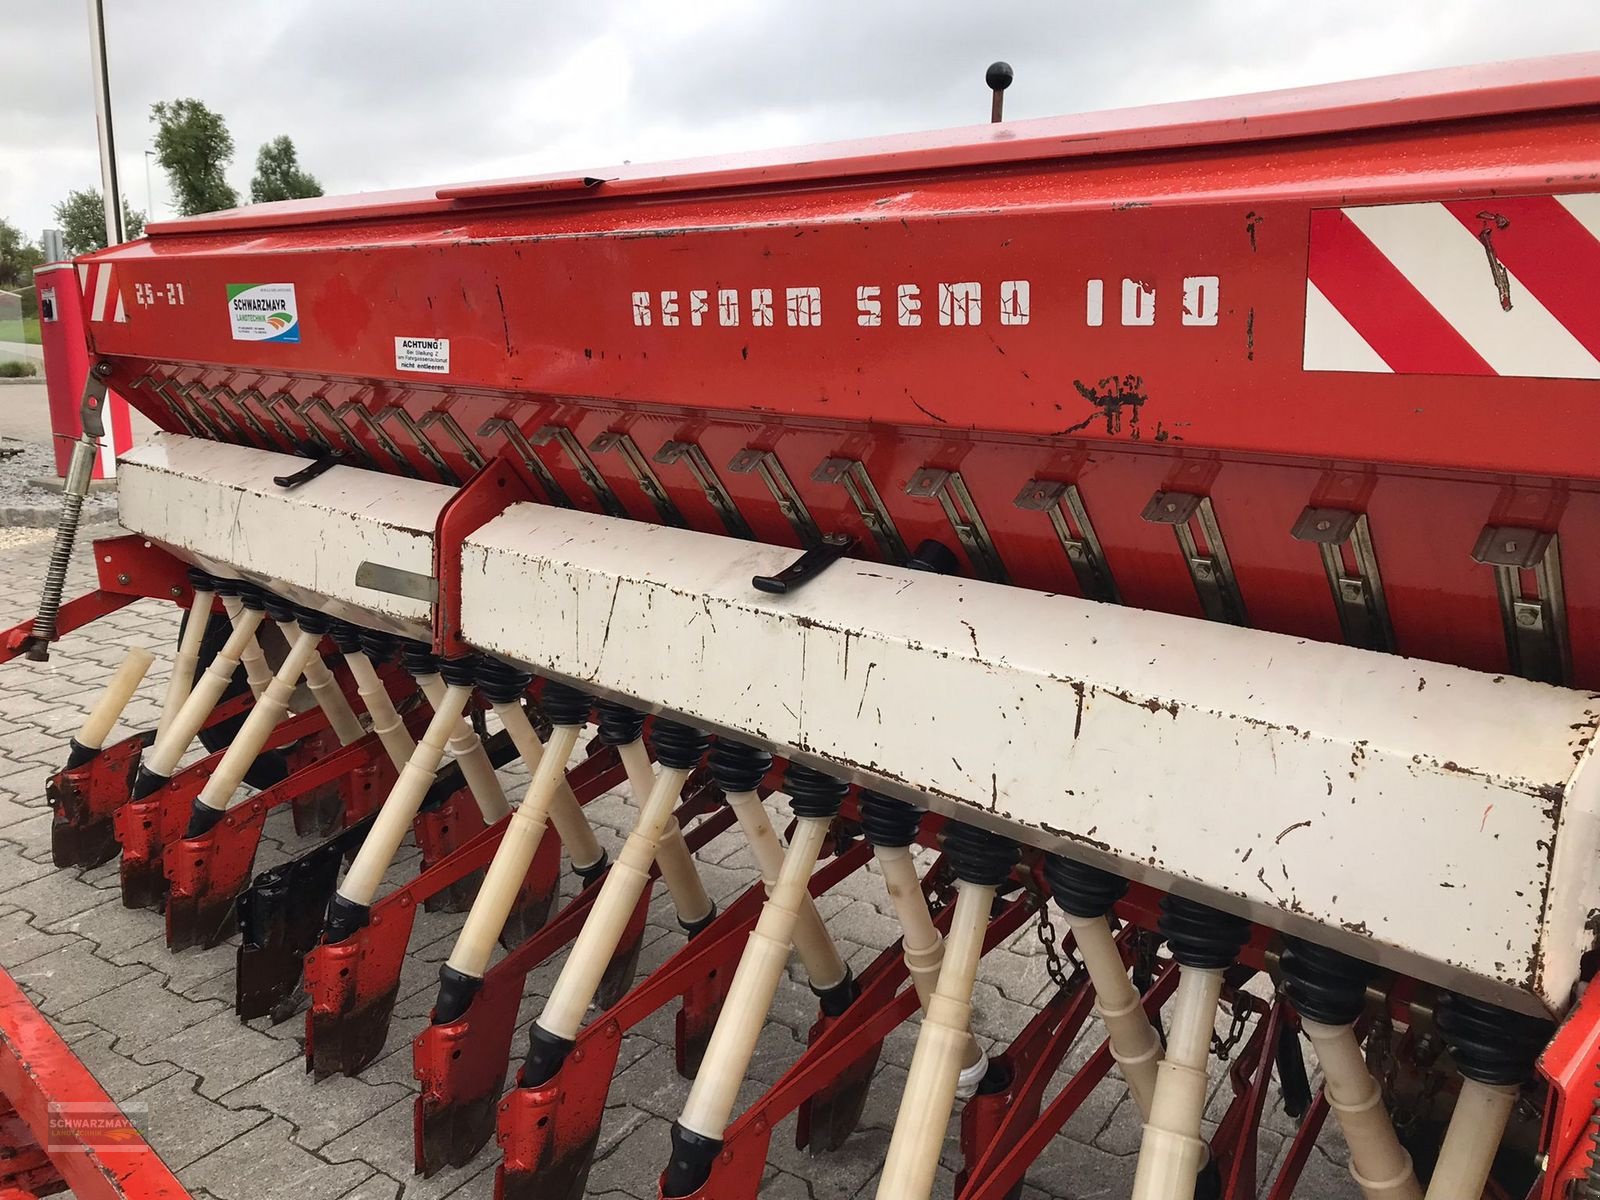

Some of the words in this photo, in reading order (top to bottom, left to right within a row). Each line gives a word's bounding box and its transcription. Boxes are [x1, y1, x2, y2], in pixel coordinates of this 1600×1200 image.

[233, 299, 287, 311] SCHWARZMAYR
[631, 286, 822, 327] REFORM
[856, 280, 1030, 327] SEMO
[1086, 276, 1220, 327] 100
